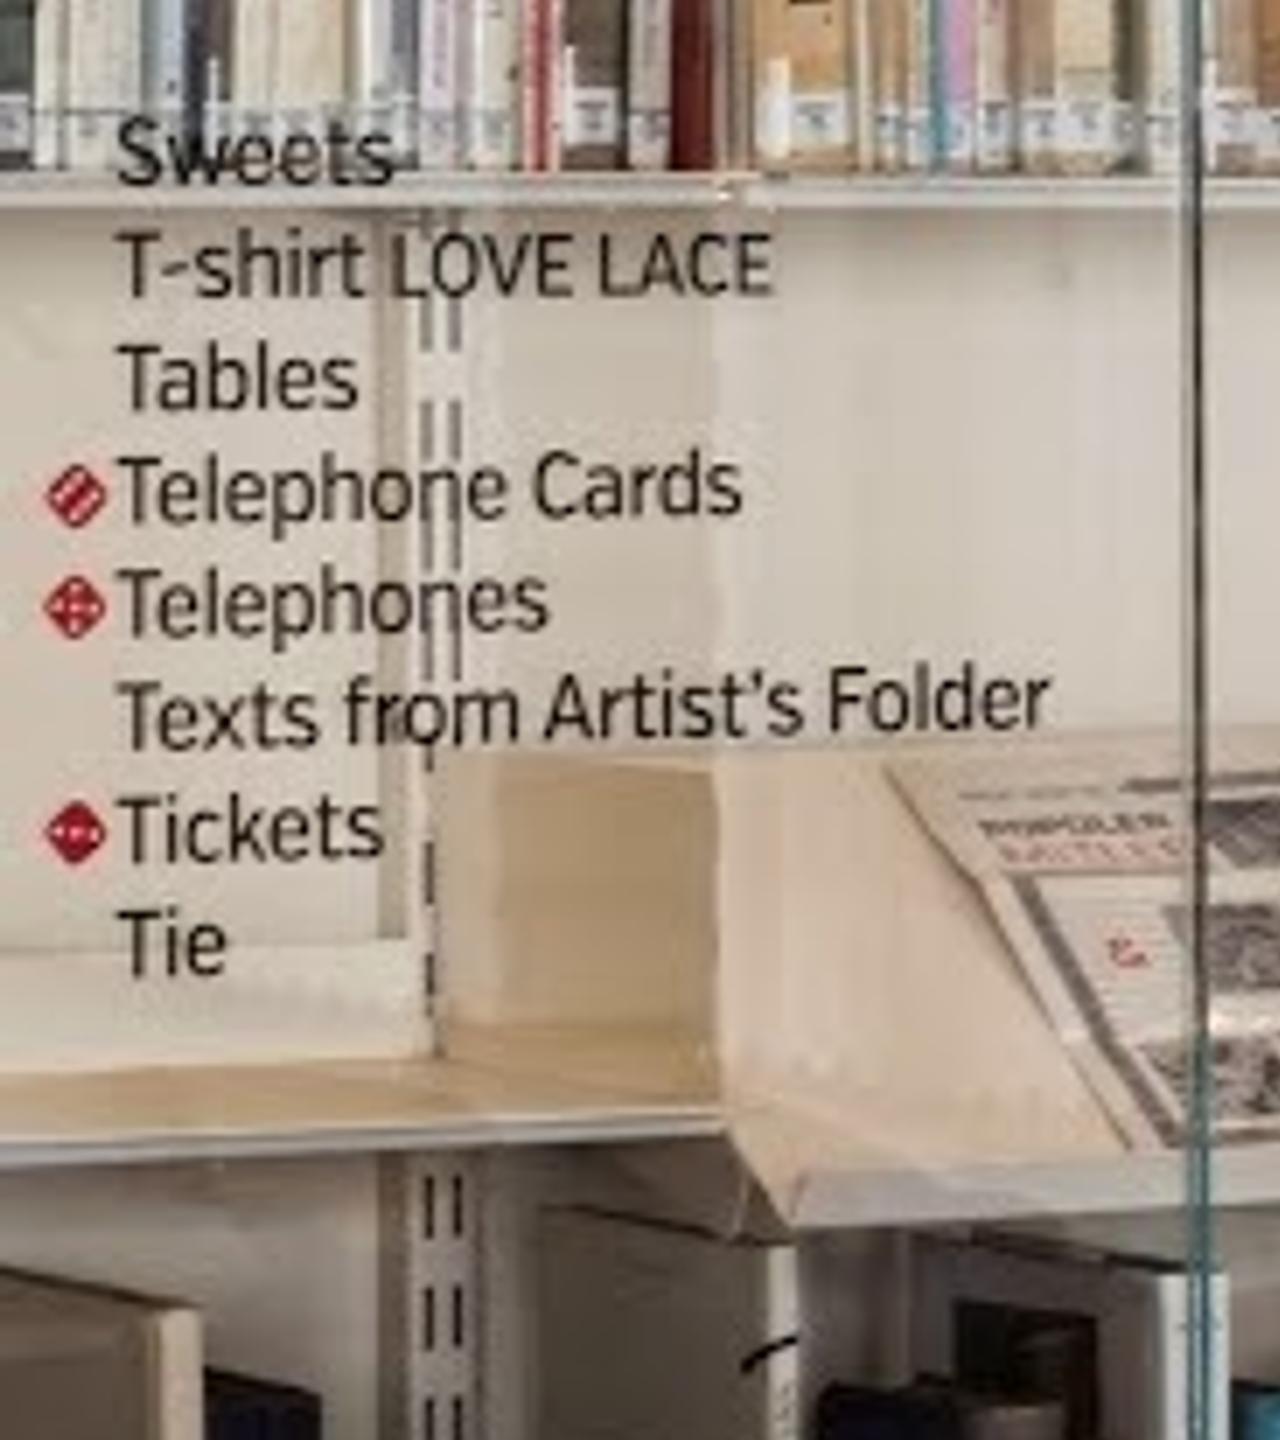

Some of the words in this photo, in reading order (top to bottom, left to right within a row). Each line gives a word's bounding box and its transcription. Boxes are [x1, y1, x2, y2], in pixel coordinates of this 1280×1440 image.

[117, 119, 396, 187] Sweets
[117, 232, 366, 299] T-shirt
[393, 231, 576, 297] LOVE
[599, 232, 775, 296] LACE
[117, 341, 361, 412] Tables
[117, 453, 509, 540] Telephone
[534, 446, 745, 520] Cards
[117, 568, 550, 653] Telephones
[117, 682, 322, 754] Texts
[347, 675, 519, 745] from
[827, 660, 1052, 735] Folder
[117, 792, 386, 866] Tickets
[117, 909, 227, 978] Tie
